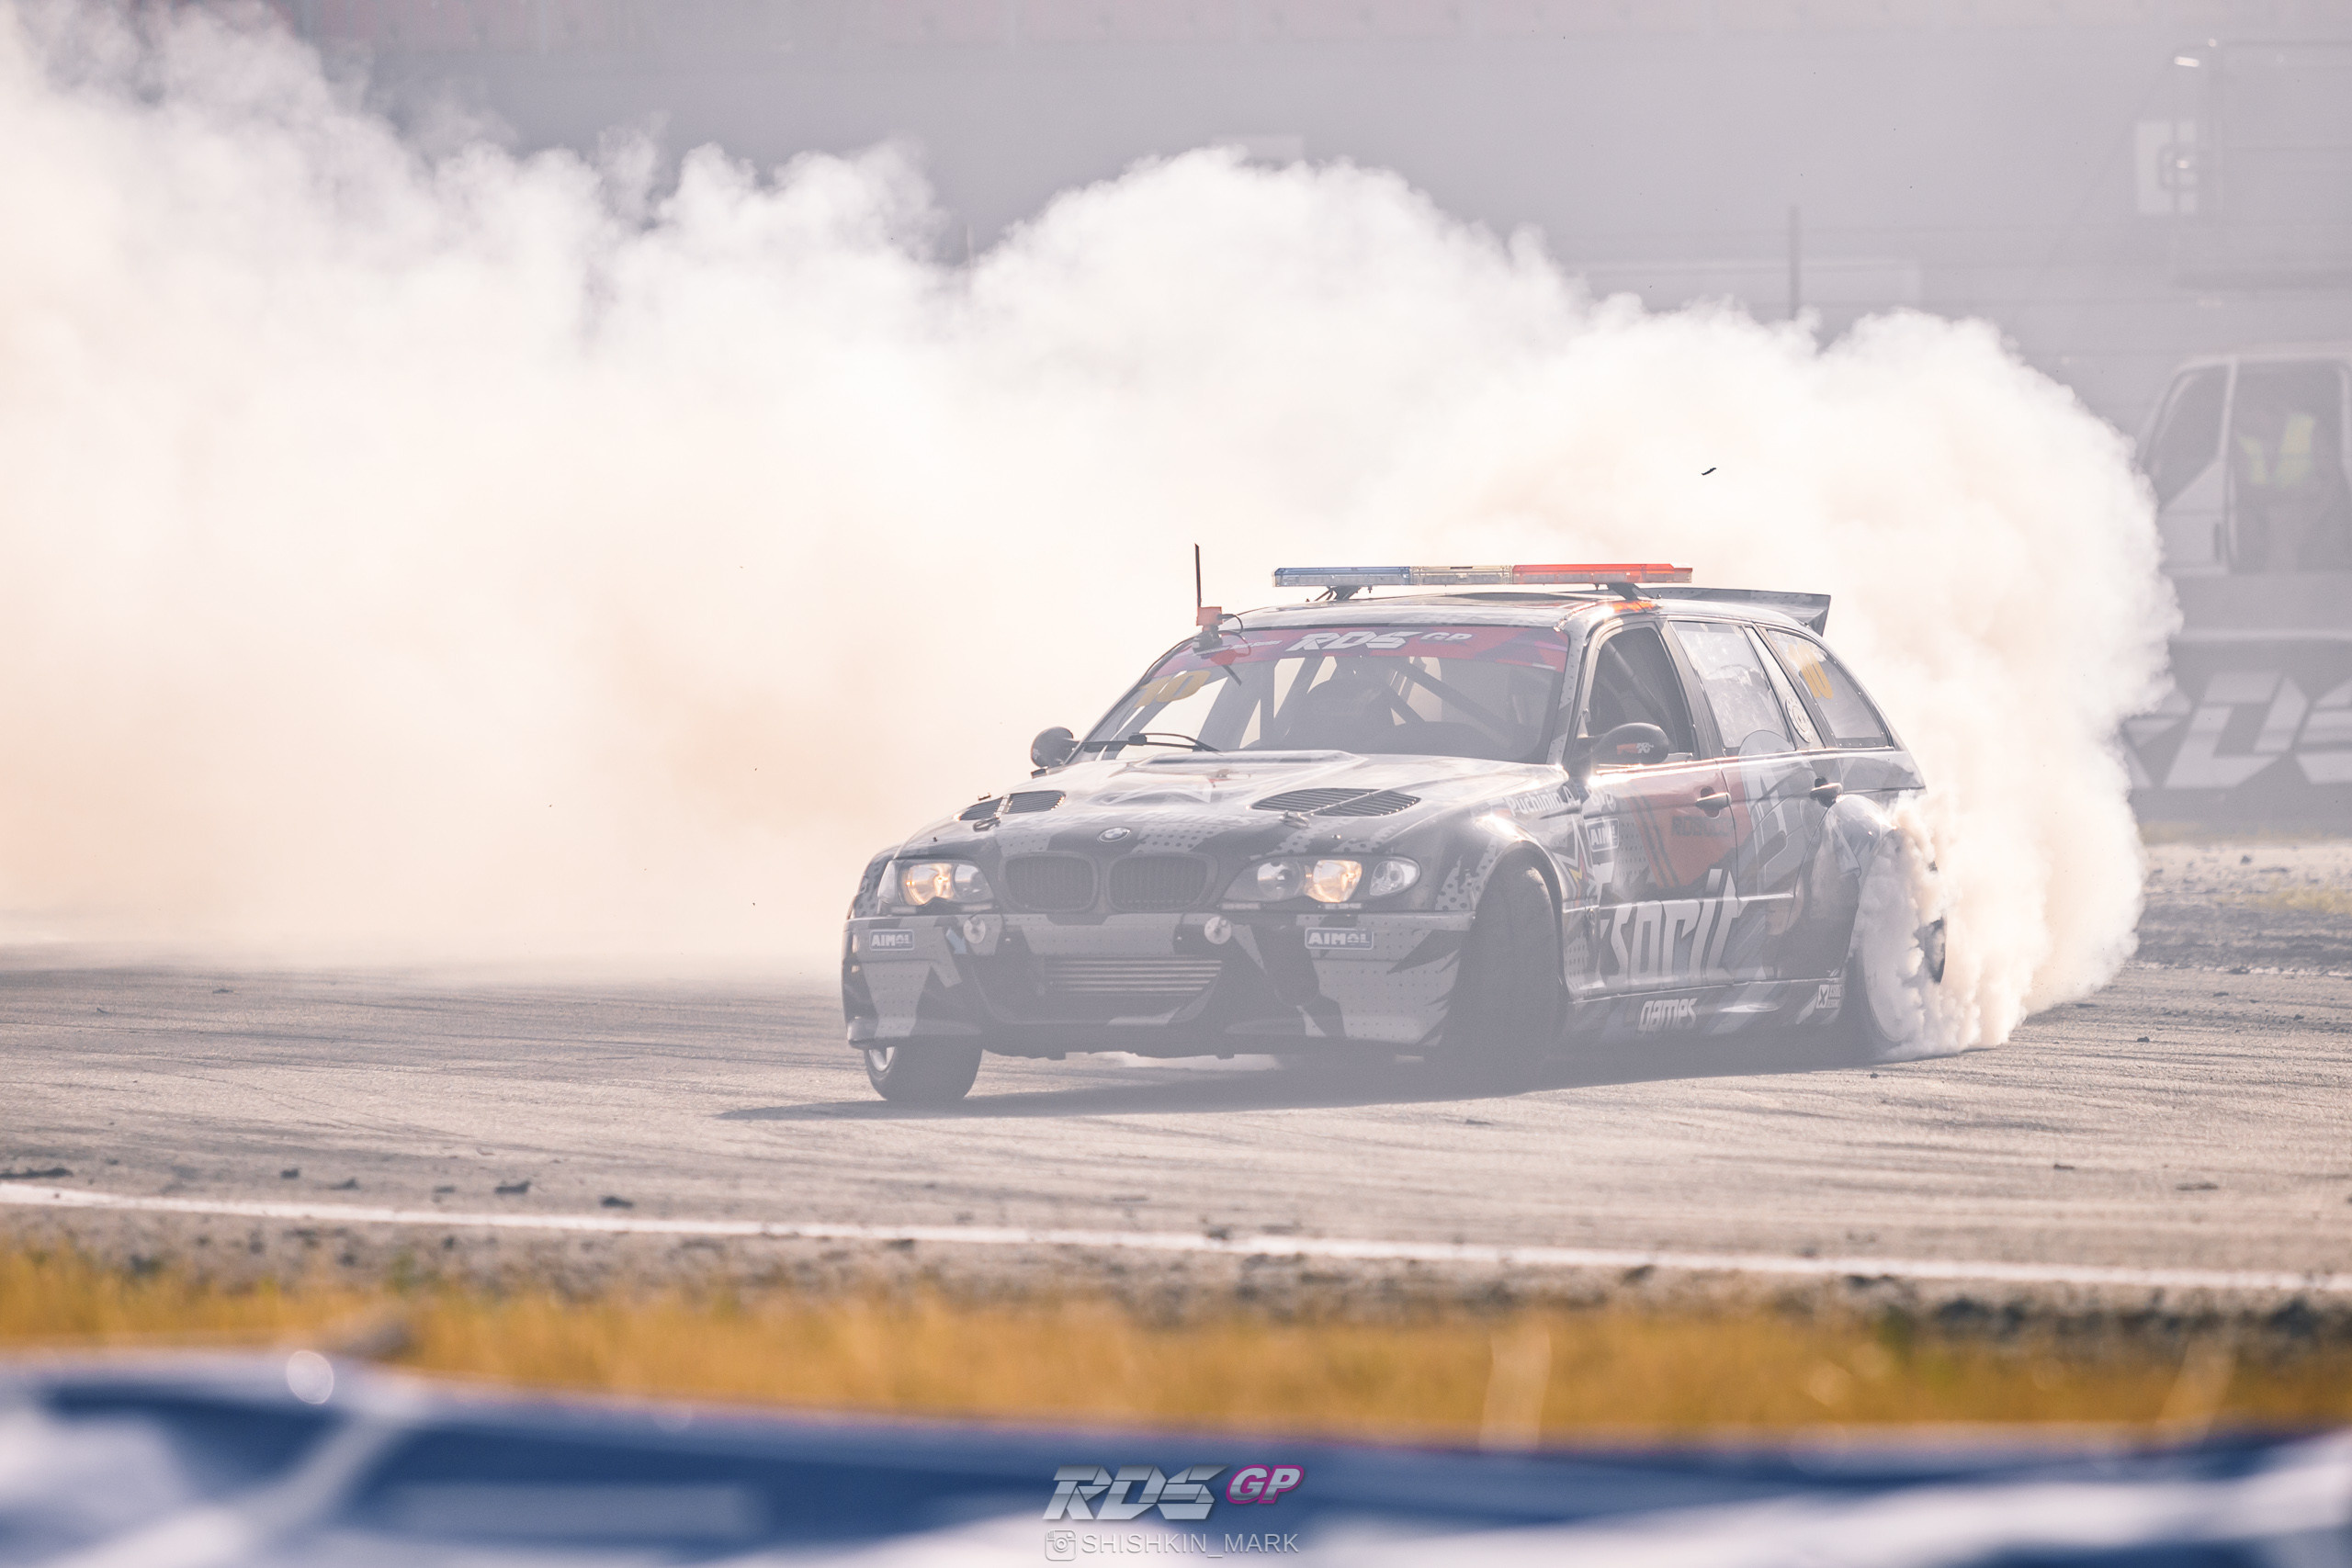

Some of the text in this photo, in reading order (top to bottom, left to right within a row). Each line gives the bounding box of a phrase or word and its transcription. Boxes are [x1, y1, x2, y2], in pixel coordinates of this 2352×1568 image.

[1283, 631, 1425, 653] RDS
[1419, 632, 1476, 642] GP
[871, 933, 912, 947] AIMOL
[1306, 931, 1371, 946] AIMOL
